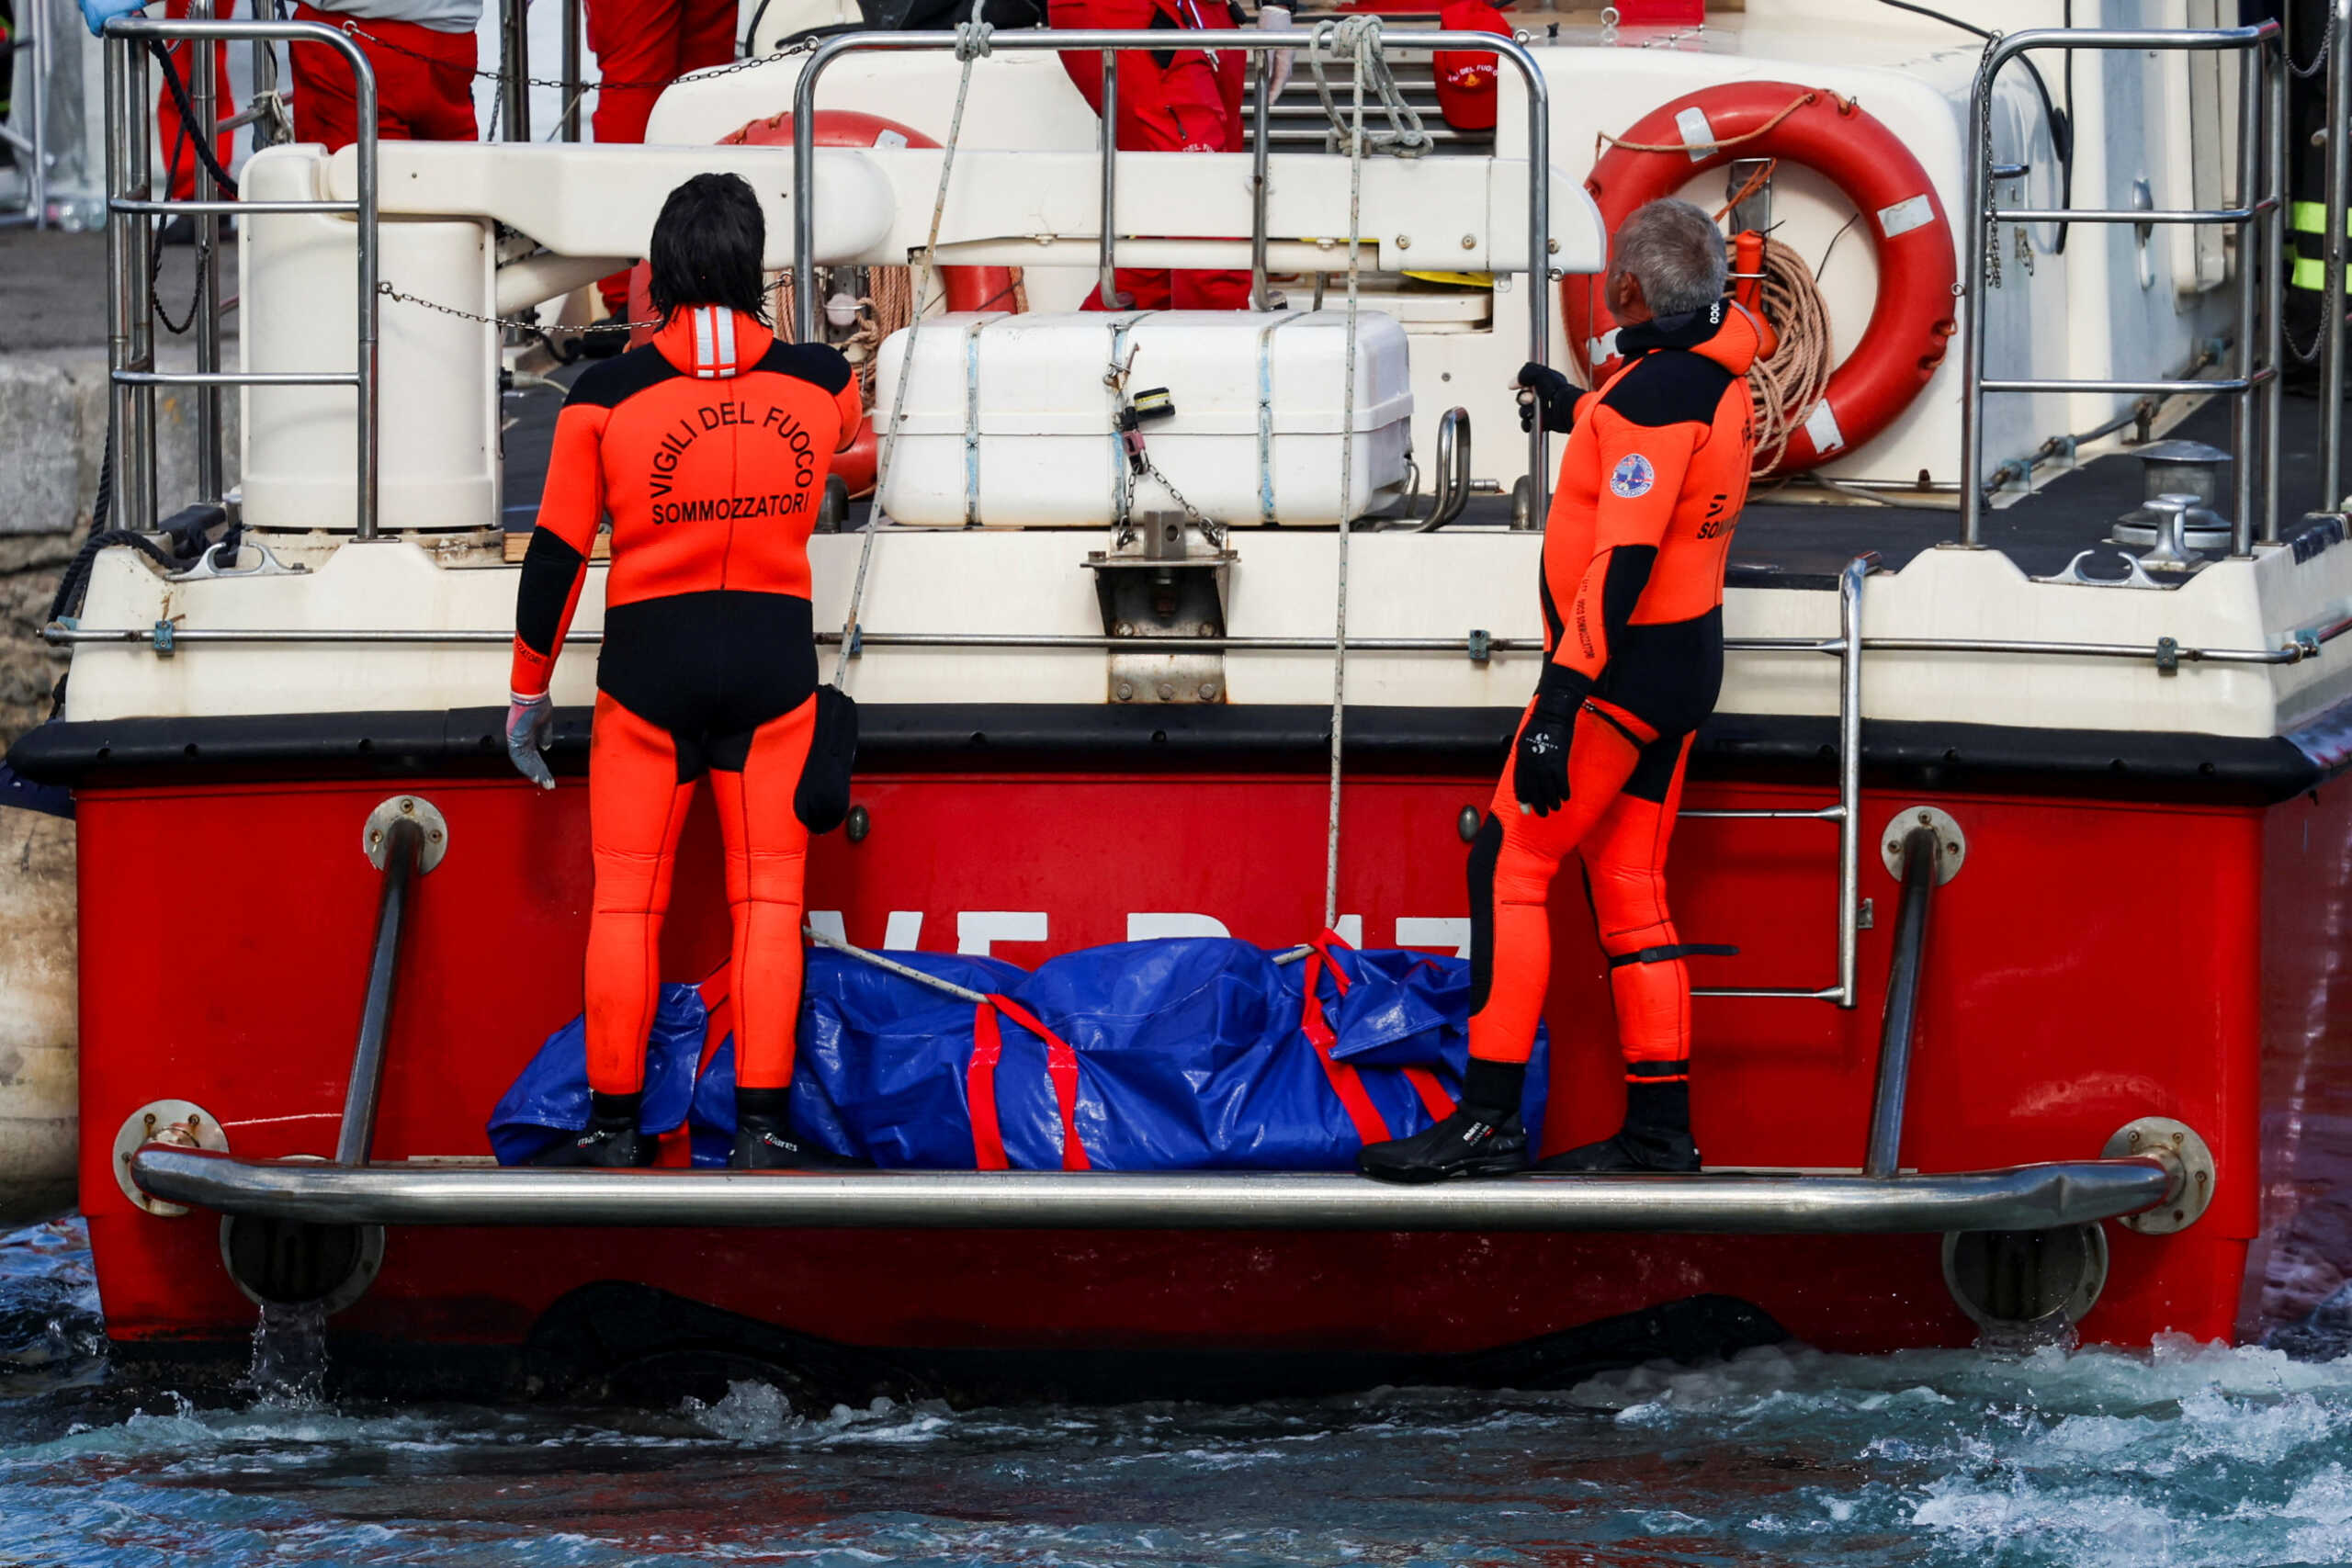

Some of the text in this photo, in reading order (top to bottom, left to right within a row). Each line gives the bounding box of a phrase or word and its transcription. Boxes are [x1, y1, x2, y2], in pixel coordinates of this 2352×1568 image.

[650, 402, 815, 498] VIGILI DEL FUOCO
[652, 493, 809, 525] SOMMOZZATORI
